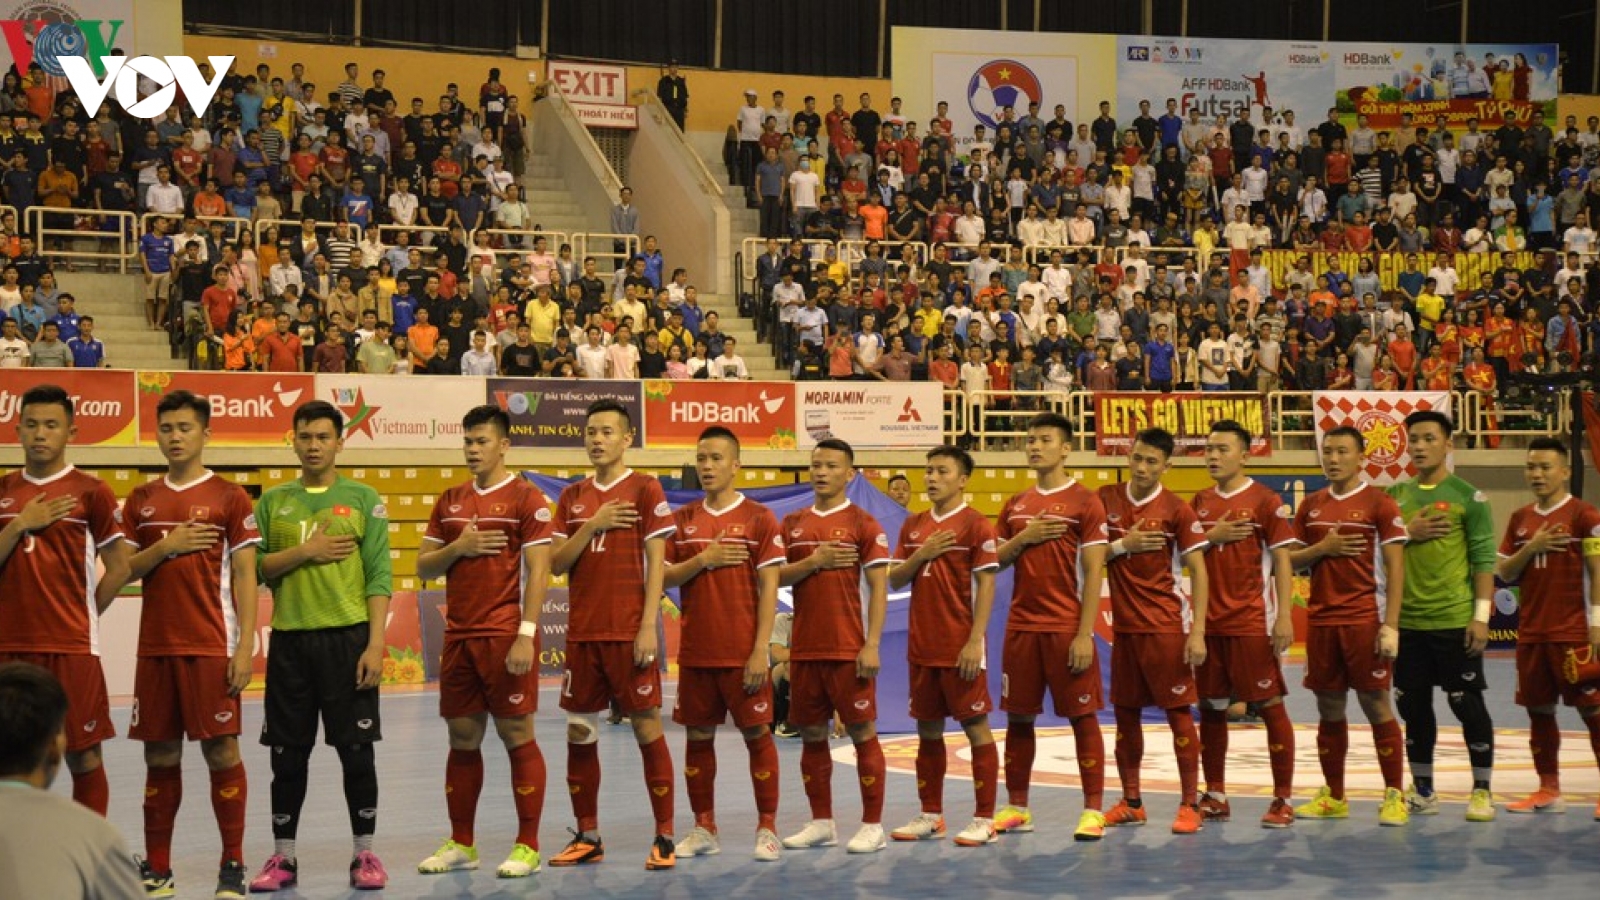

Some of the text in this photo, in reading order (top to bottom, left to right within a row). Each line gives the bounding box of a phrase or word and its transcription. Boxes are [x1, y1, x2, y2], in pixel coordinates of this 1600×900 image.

[1289, 54, 1320, 64] HDBank
[1343, 52, 1392, 65] HDBank
[554, 69, 619, 97] EXIT
[1182, 78, 1250, 91] AFF HDBank
[578, 108, 607, 119] THOÁT
[1181, 93, 1250, 117] Futsal
[194, 394, 275, 418] Bank
[493, 391, 543, 416] VOV
[804, 391, 865, 405] MORIAMIN
[670, 401, 761, 424] HDBank
[1101, 397, 1263, 436] LET'S GO VIETNAM
[371, 418, 463, 439] Vietnam Journ
[509, 424, 536, 436] ANH,
[538, 424, 557, 435] TIN
[542, 599, 569, 614] IẾNG
